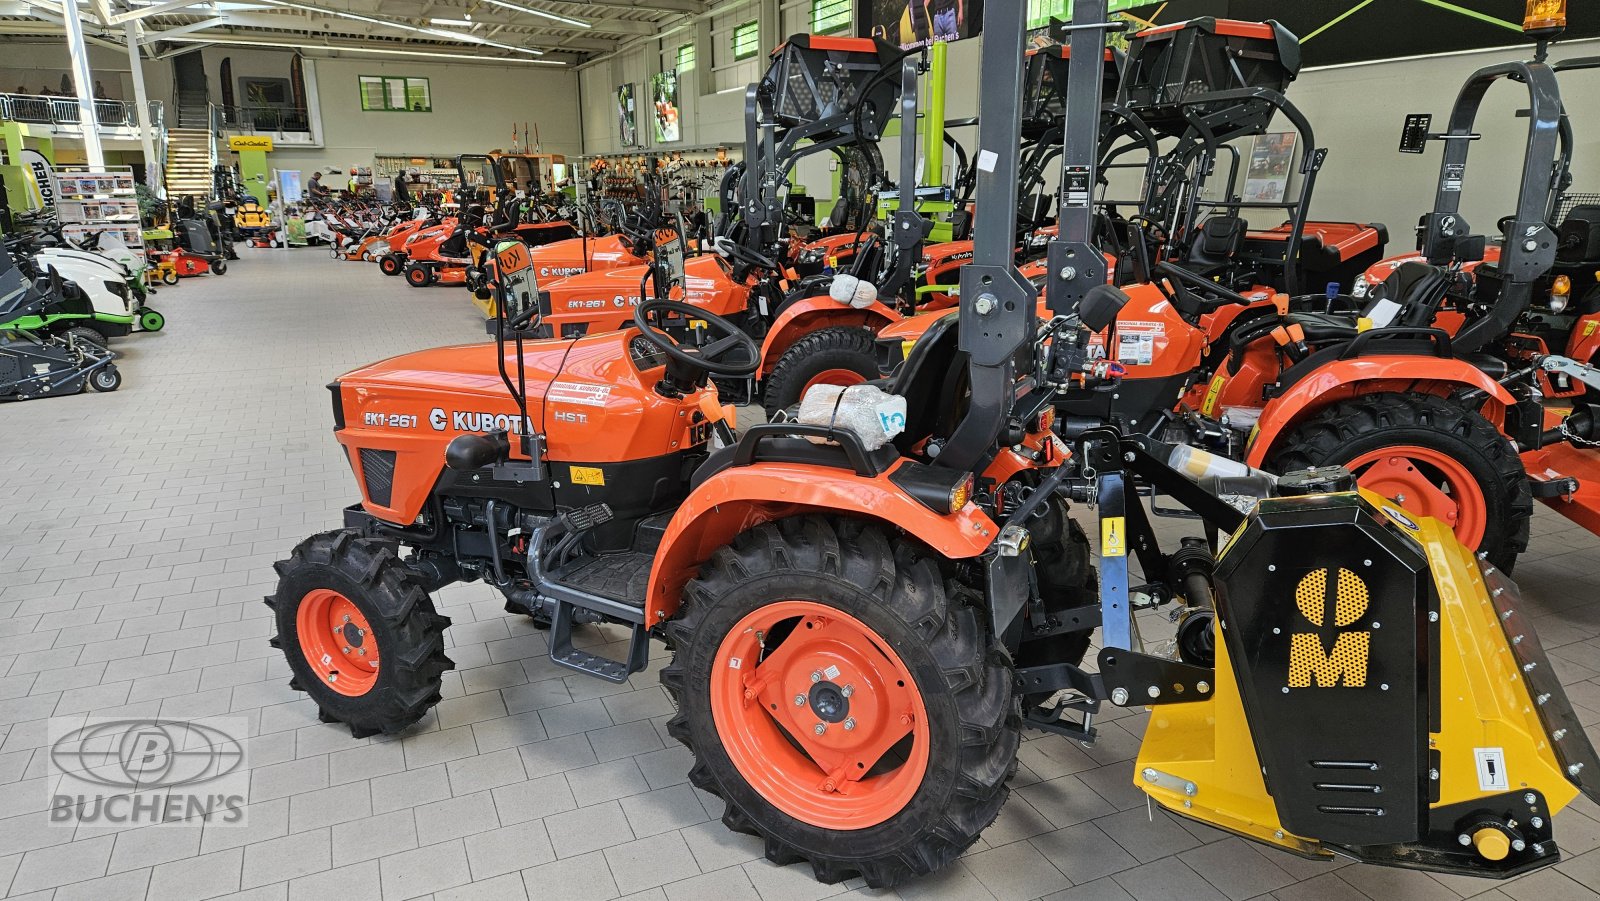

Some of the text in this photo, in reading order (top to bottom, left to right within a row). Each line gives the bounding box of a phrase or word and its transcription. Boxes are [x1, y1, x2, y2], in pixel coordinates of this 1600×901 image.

[925, 36, 934, 46] bei
[551, 267, 586, 277] KUBOT
[567, 299, 606, 309] EK1-261
[364, 411, 418, 428] EK1-261
[452, 410, 536, 435] KUBOTA
[554, 411, 587, 423] HST
